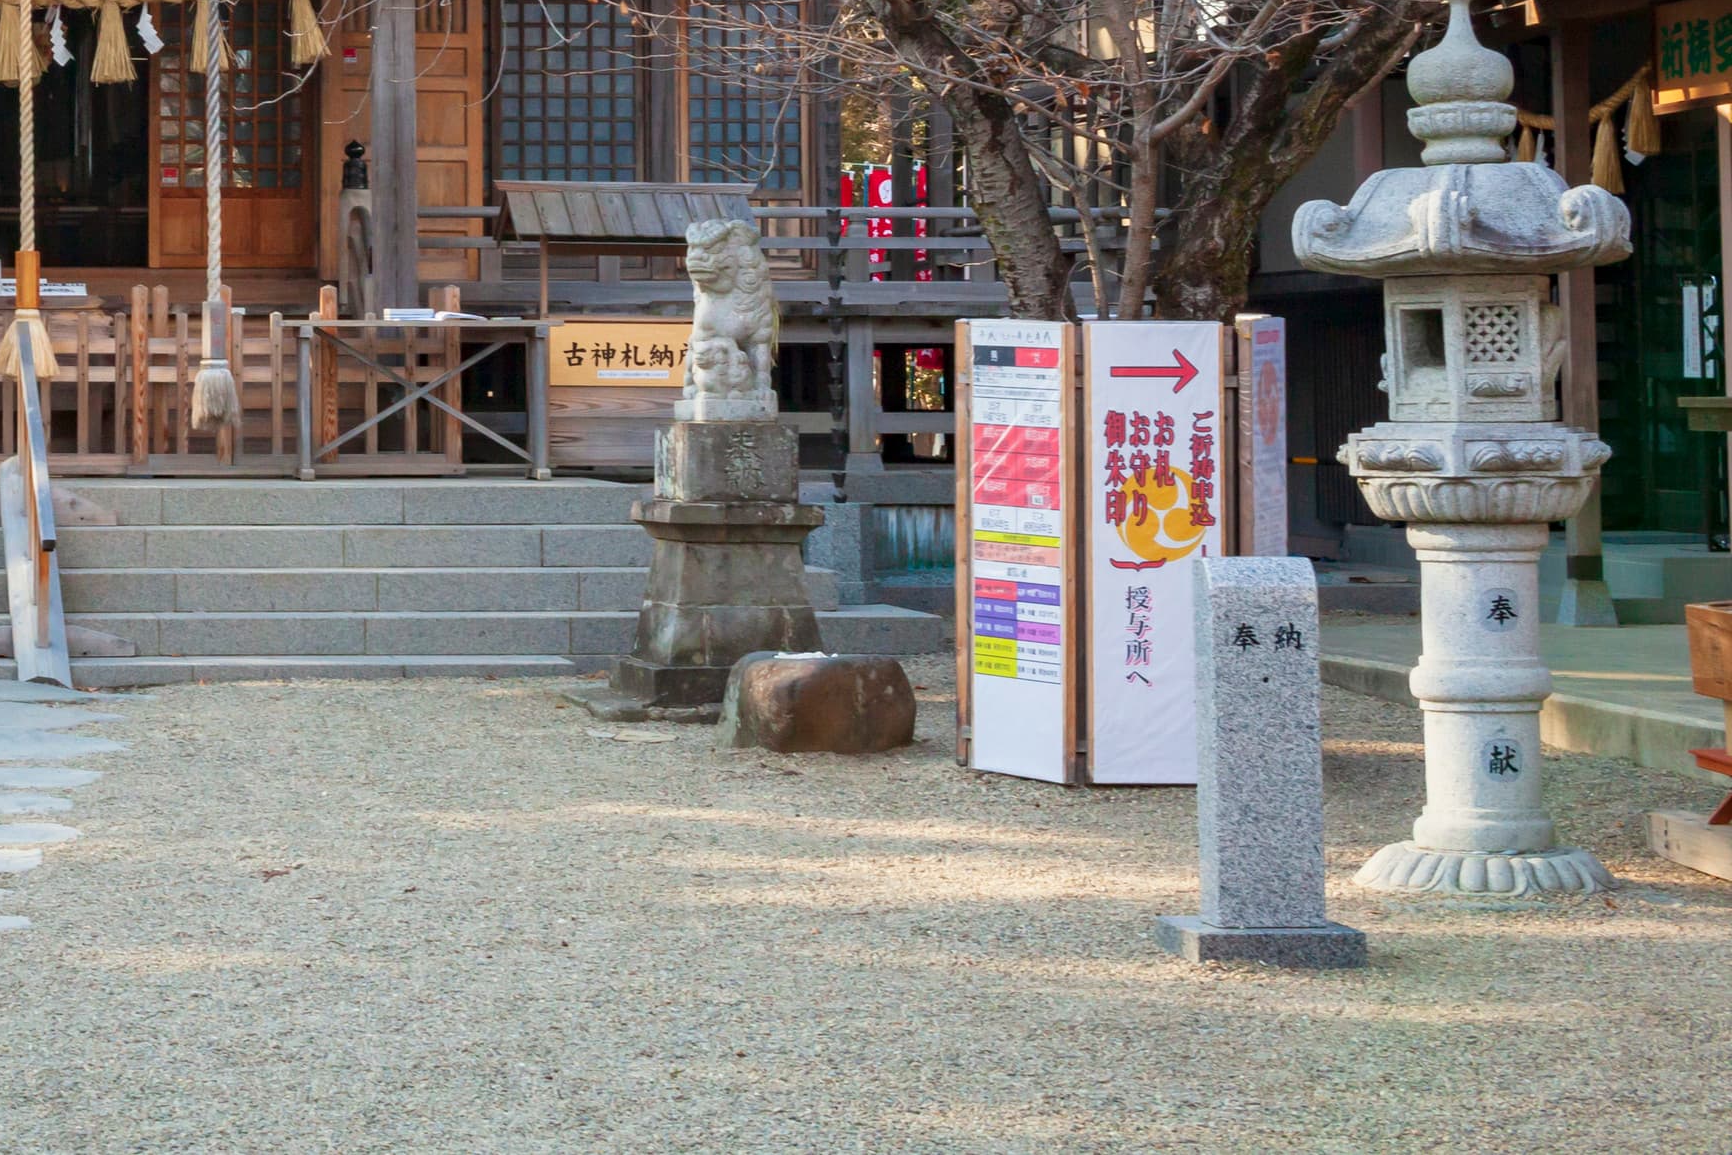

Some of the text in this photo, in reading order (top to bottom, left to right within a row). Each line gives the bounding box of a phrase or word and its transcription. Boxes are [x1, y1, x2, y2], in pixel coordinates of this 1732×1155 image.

[1103, 409, 1127, 527] 御朱印
[1128, 410, 1151, 527] お守り
[1153, 410, 1176, 488] お札
[1125, 585, 1153, 687] 授与所へ
[1233, 622, 1306, 652] 奉納
